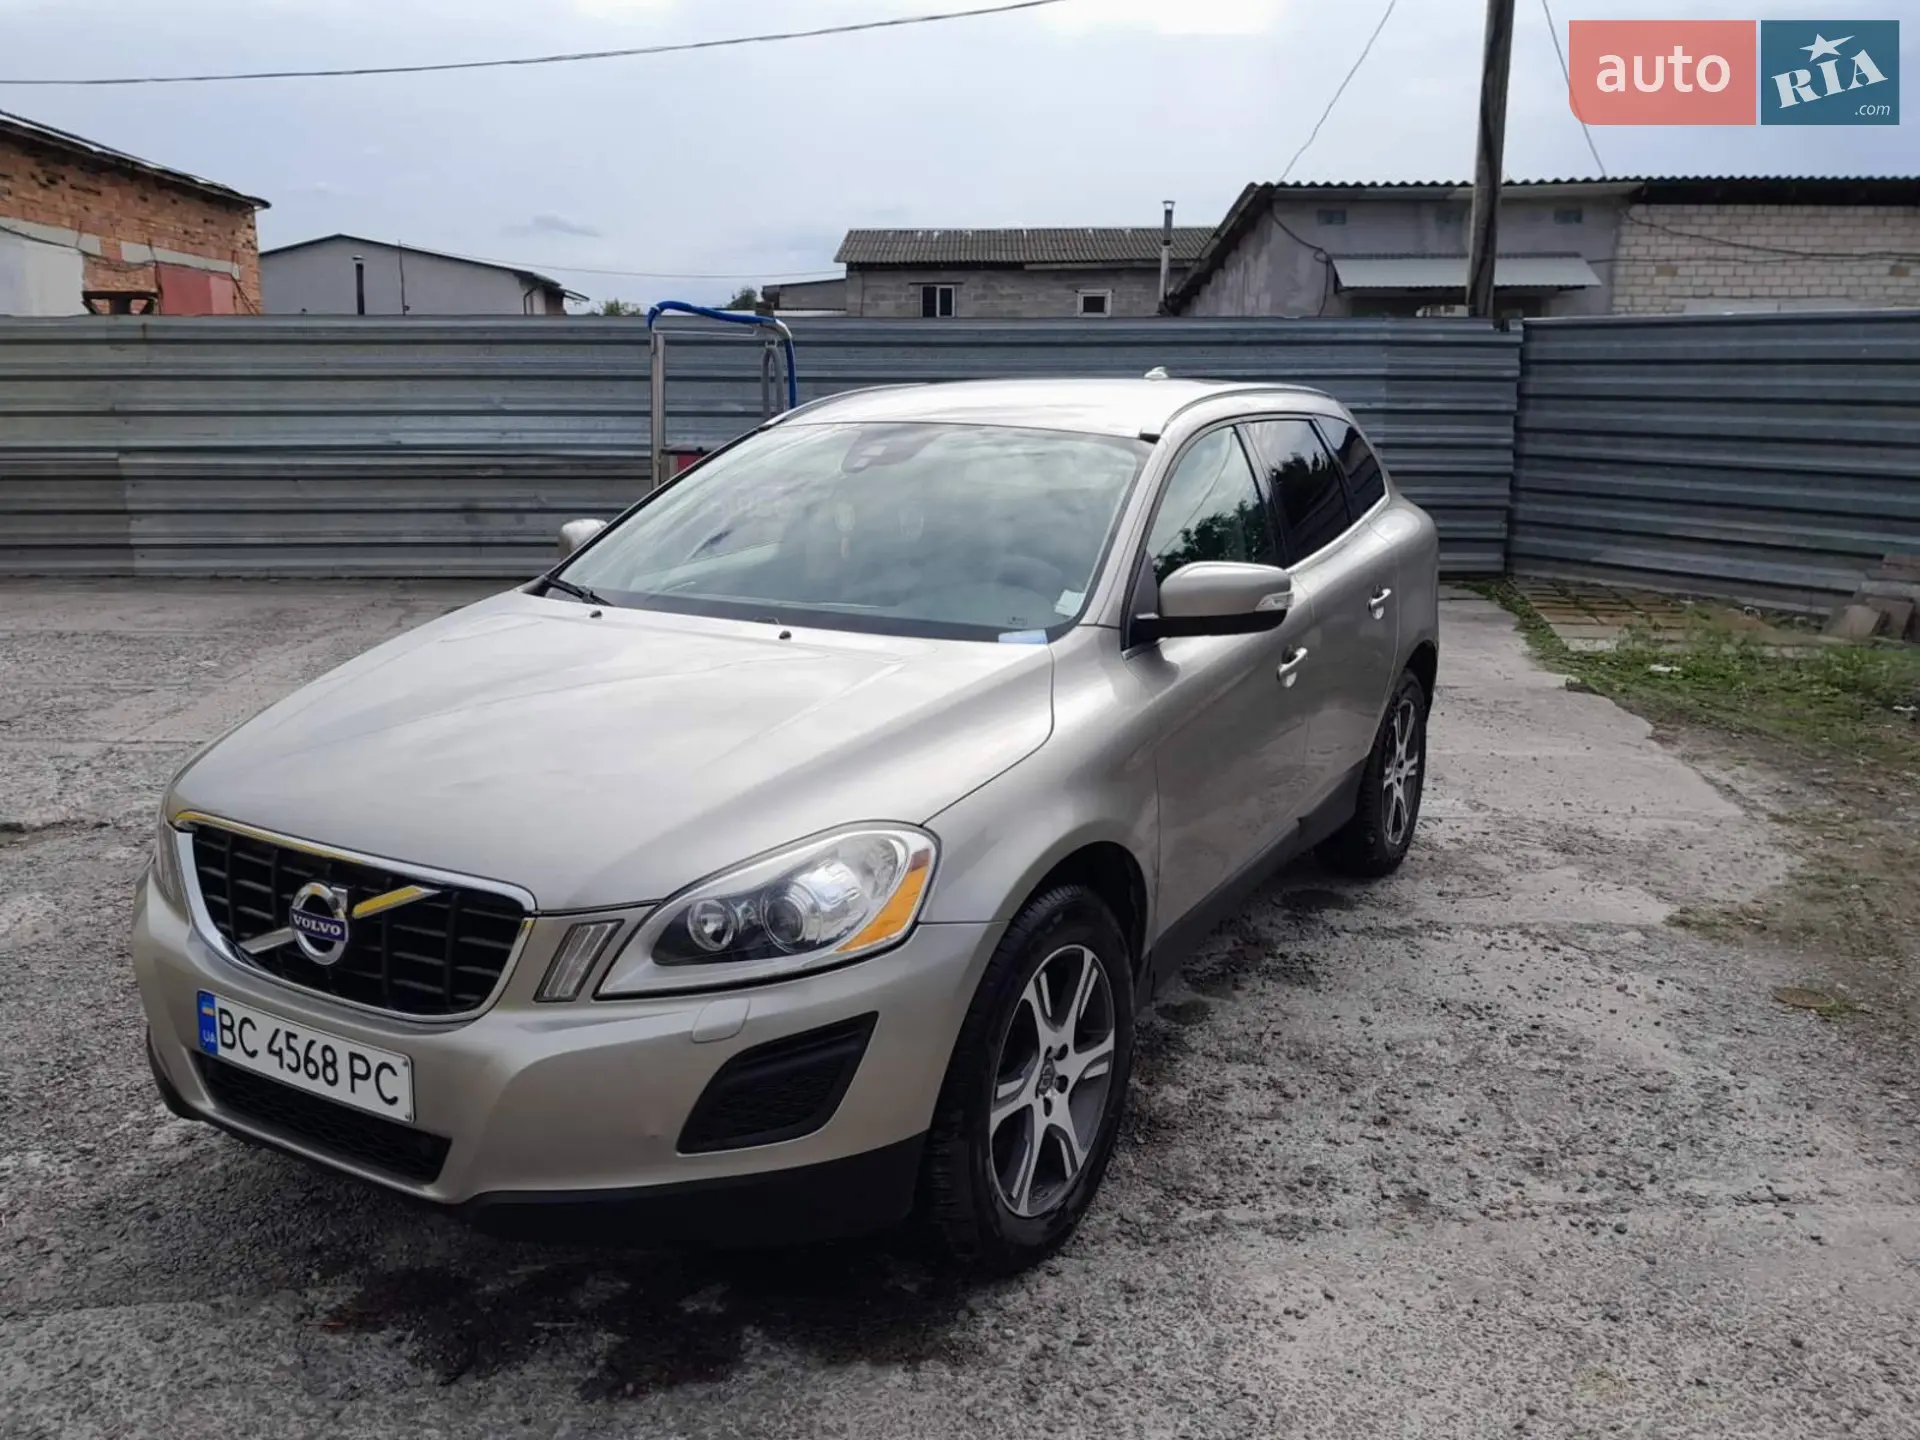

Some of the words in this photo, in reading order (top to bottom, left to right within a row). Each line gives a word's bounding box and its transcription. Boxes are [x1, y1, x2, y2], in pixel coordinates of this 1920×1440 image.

[292, 914, 342, 936] VOLVO
[203, 1030, 216, 1043] UA
[218, 1007, 258, 1058] BC
[267, 1028, 338, 1087] 4568
[349, 1051, 398, 1105] PC
